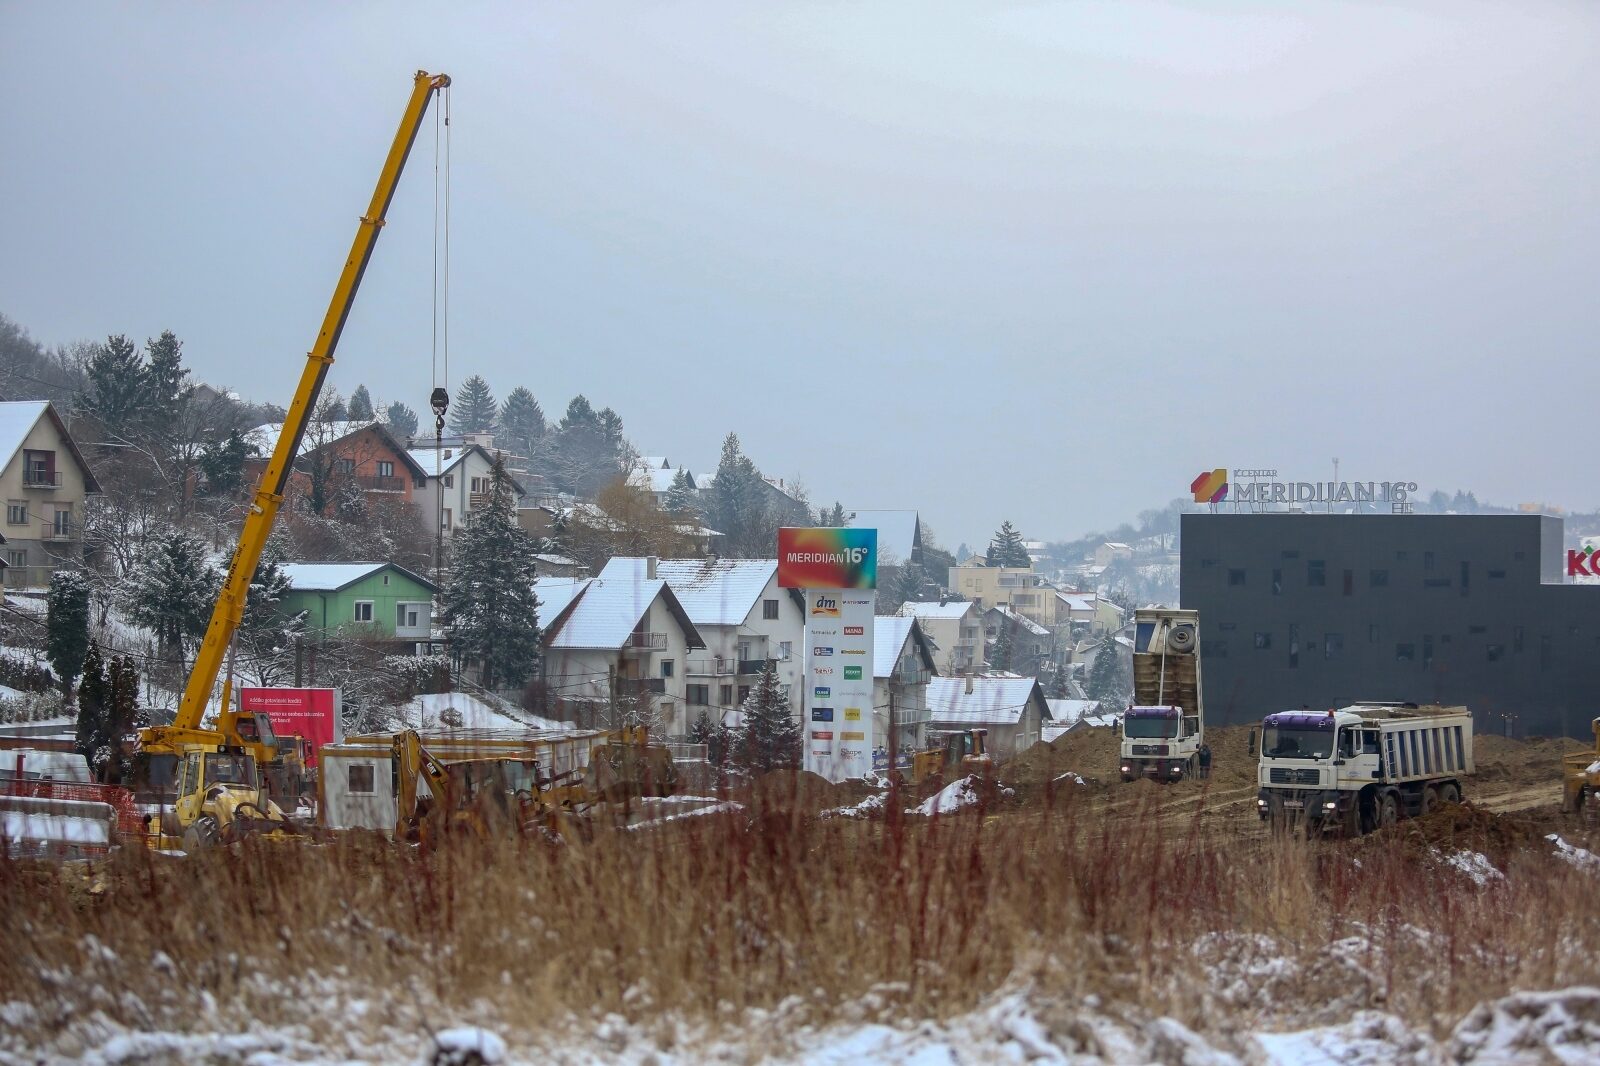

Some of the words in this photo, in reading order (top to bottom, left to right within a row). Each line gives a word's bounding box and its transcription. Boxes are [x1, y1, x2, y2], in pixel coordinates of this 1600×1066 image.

[1233, 482, 1375, 503] MERIDIJAN
[1381, 482, 1418, 503] 16°
[787, 552, 843, 563] MERIDIJAN
[816, 595, 836, 608] dm
